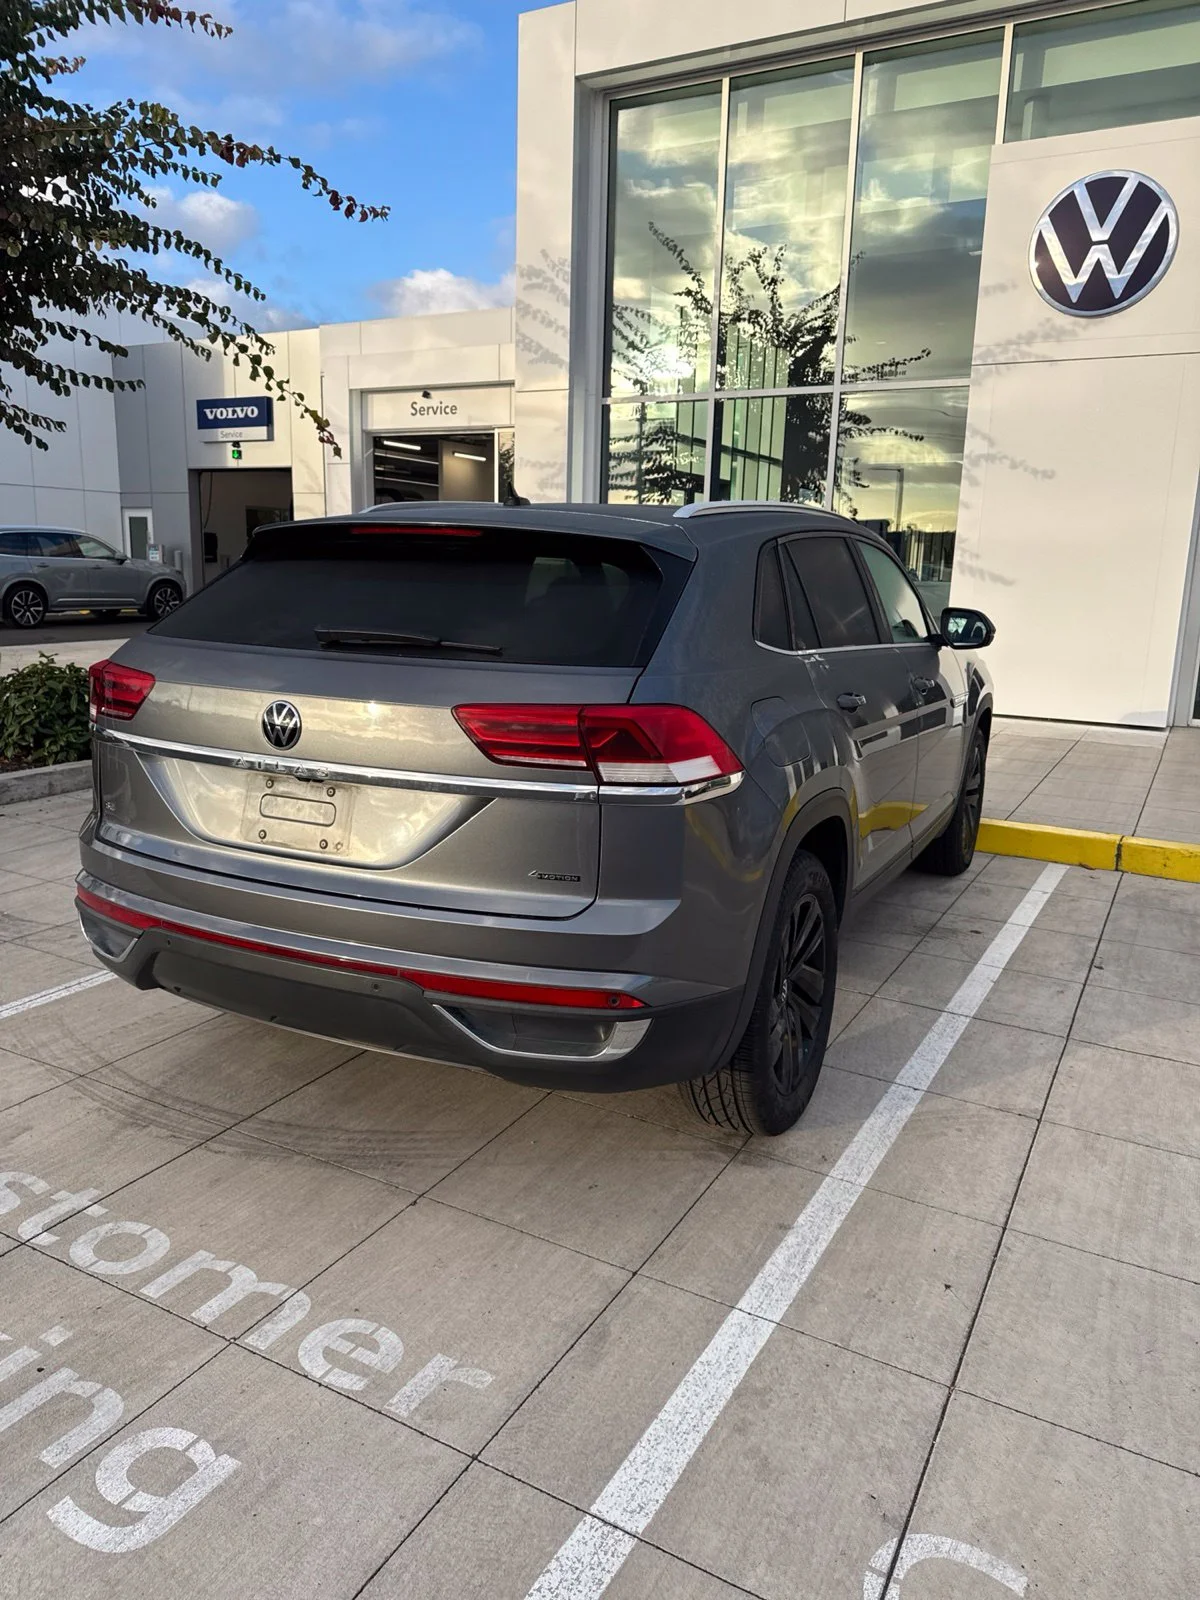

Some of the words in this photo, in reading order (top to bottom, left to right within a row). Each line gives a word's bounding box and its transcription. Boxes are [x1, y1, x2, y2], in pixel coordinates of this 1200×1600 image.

[203, 405, 259, 420] VOLVO
[409, 400, 458, 417] Service
[220, 430, 243, 439] Service
